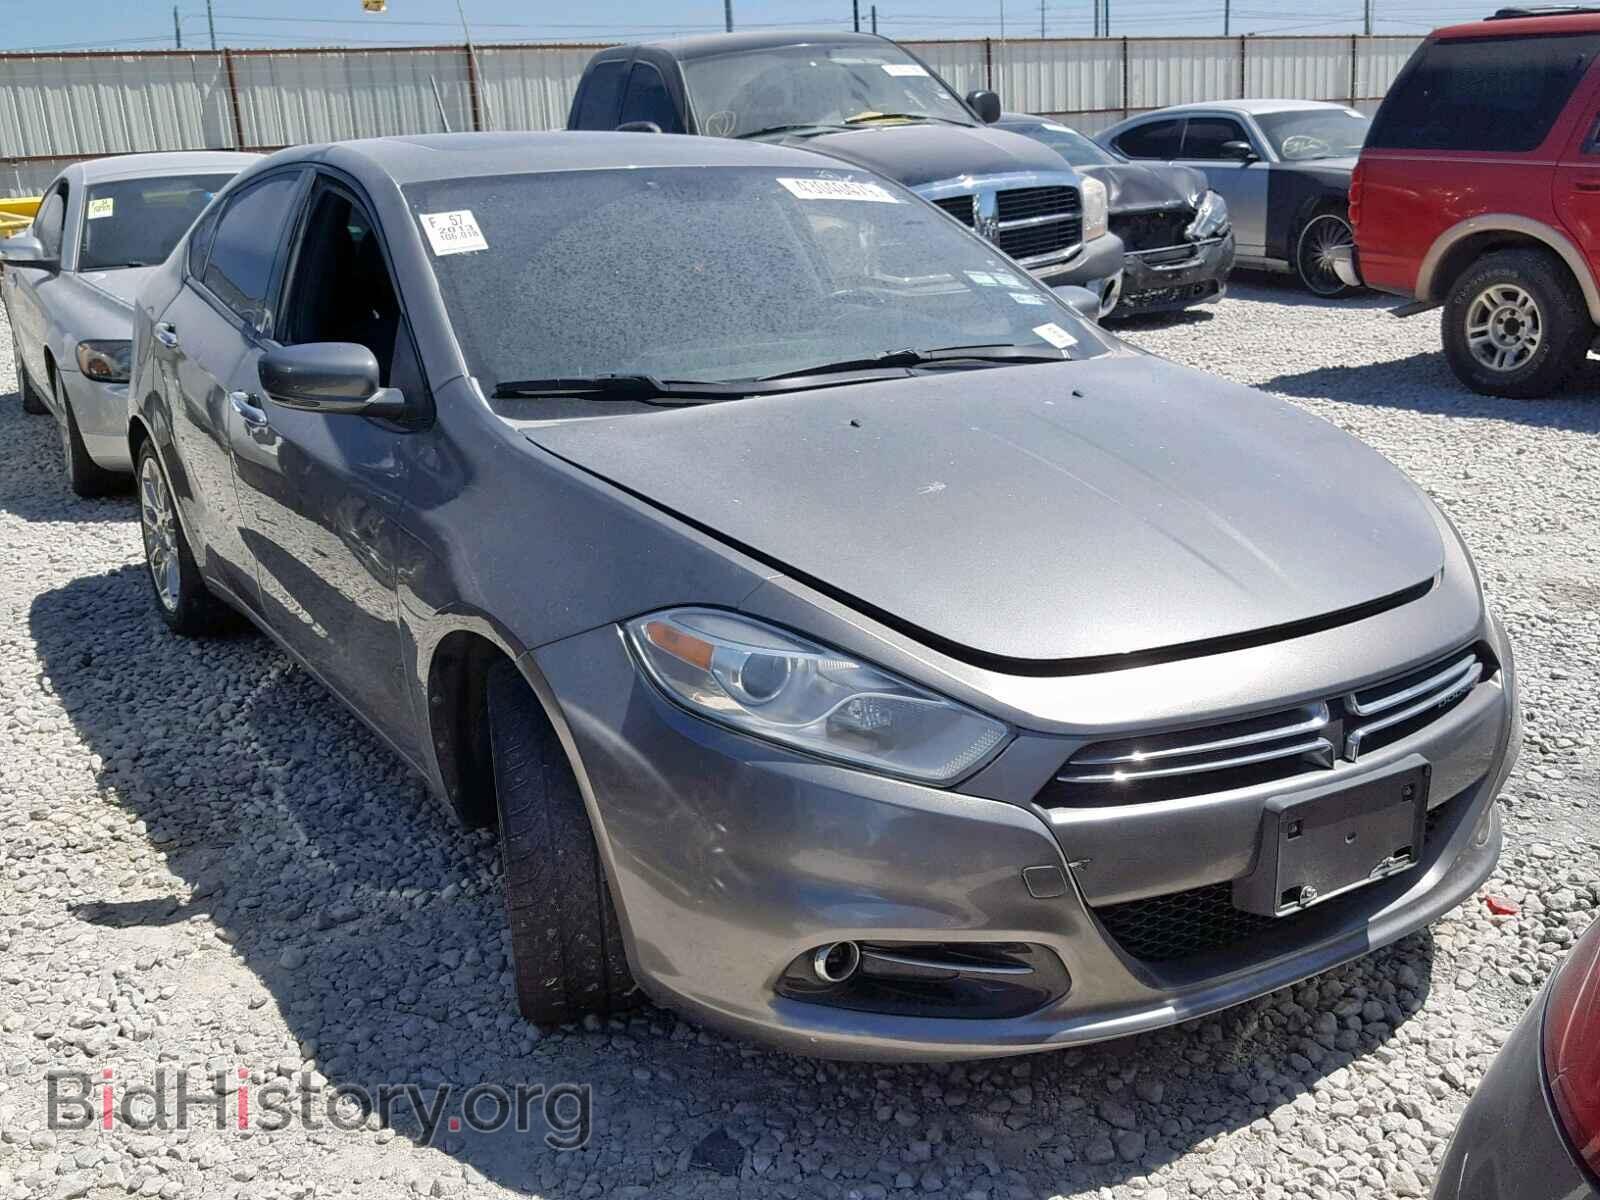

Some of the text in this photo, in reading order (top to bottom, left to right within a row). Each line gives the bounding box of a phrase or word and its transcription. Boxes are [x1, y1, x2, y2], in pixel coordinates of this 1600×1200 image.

[428, 214, 463, 228] F 57
[439, 224, 474, 234] 2013
